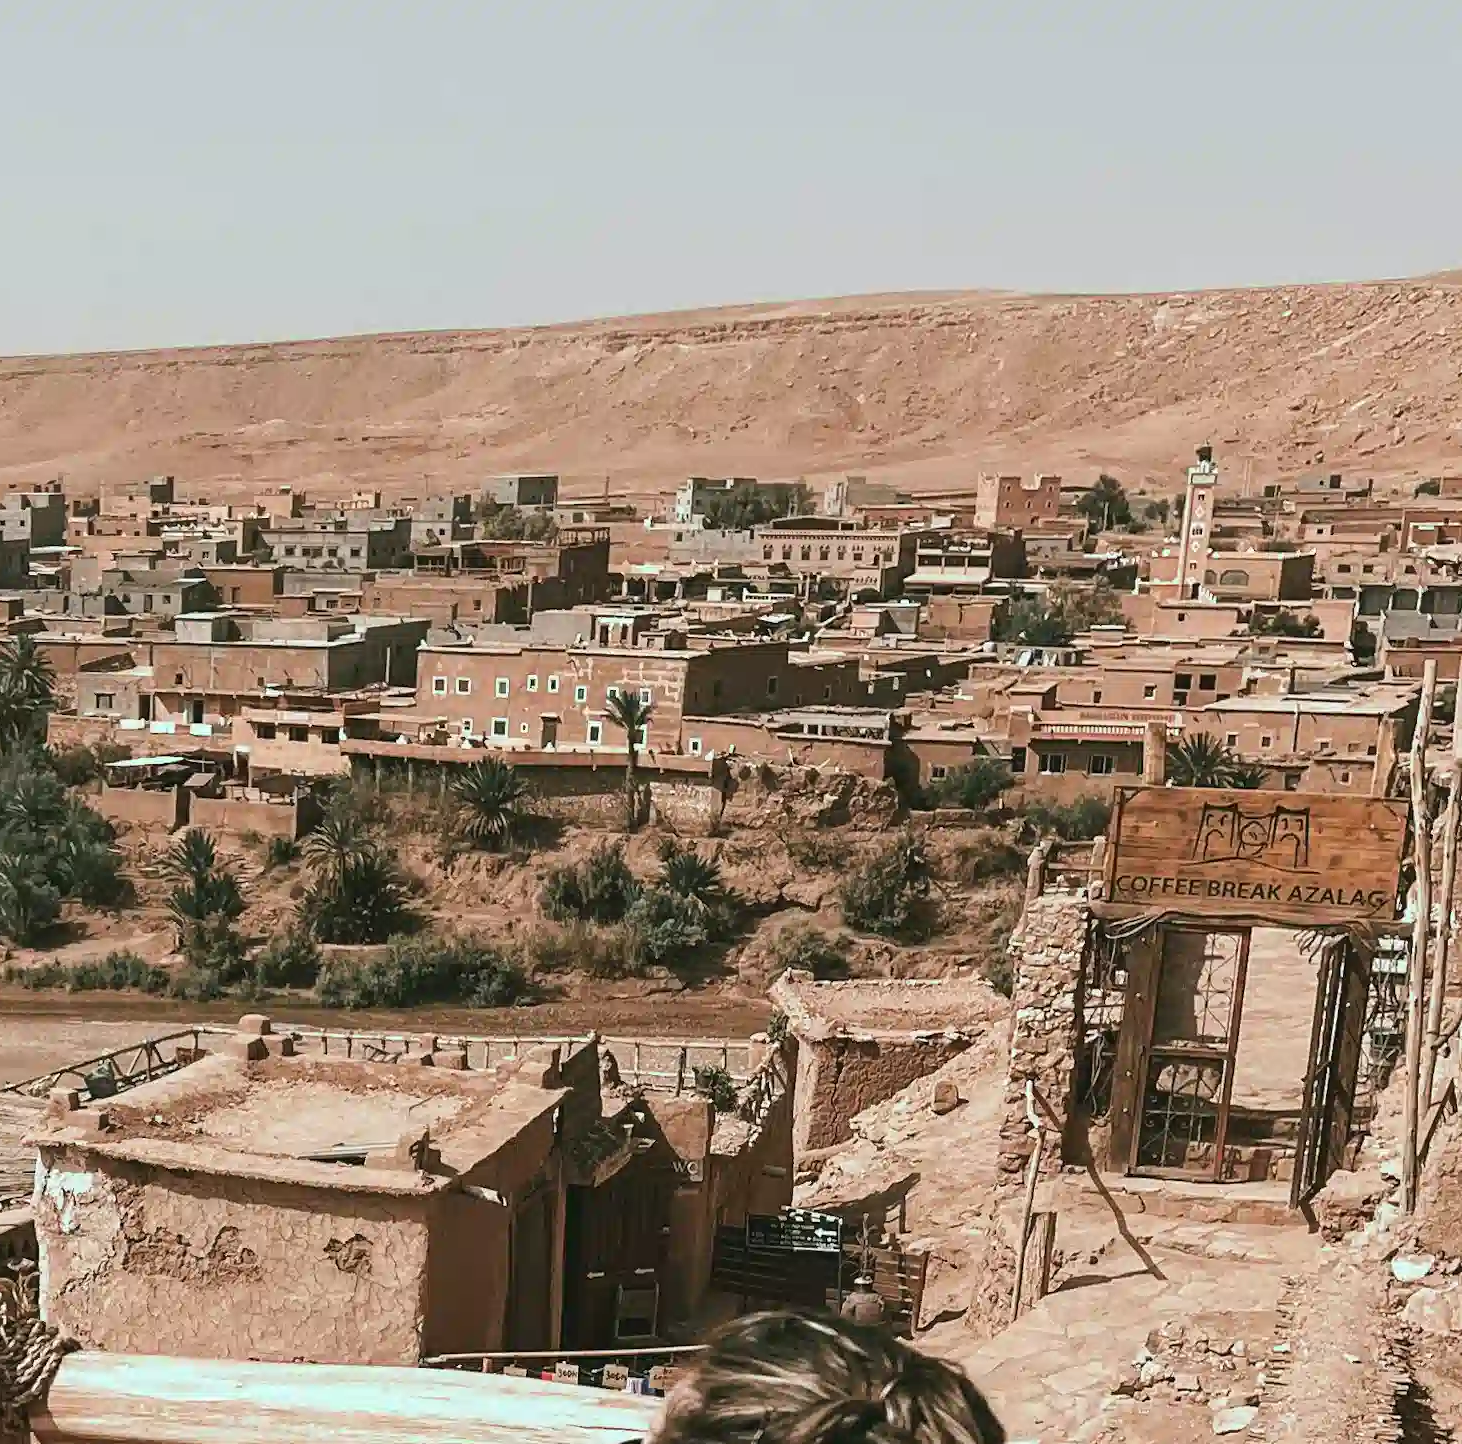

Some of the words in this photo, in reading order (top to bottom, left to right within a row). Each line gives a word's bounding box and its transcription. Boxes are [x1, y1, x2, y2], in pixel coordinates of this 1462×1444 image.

[1116, 875, 1203, 898] COFFEE
[1207, 879, 1282, 901] BREAK
[1286, 884, 1388, 908] AZALAG
[672, 1160, 699, 1175] WC
